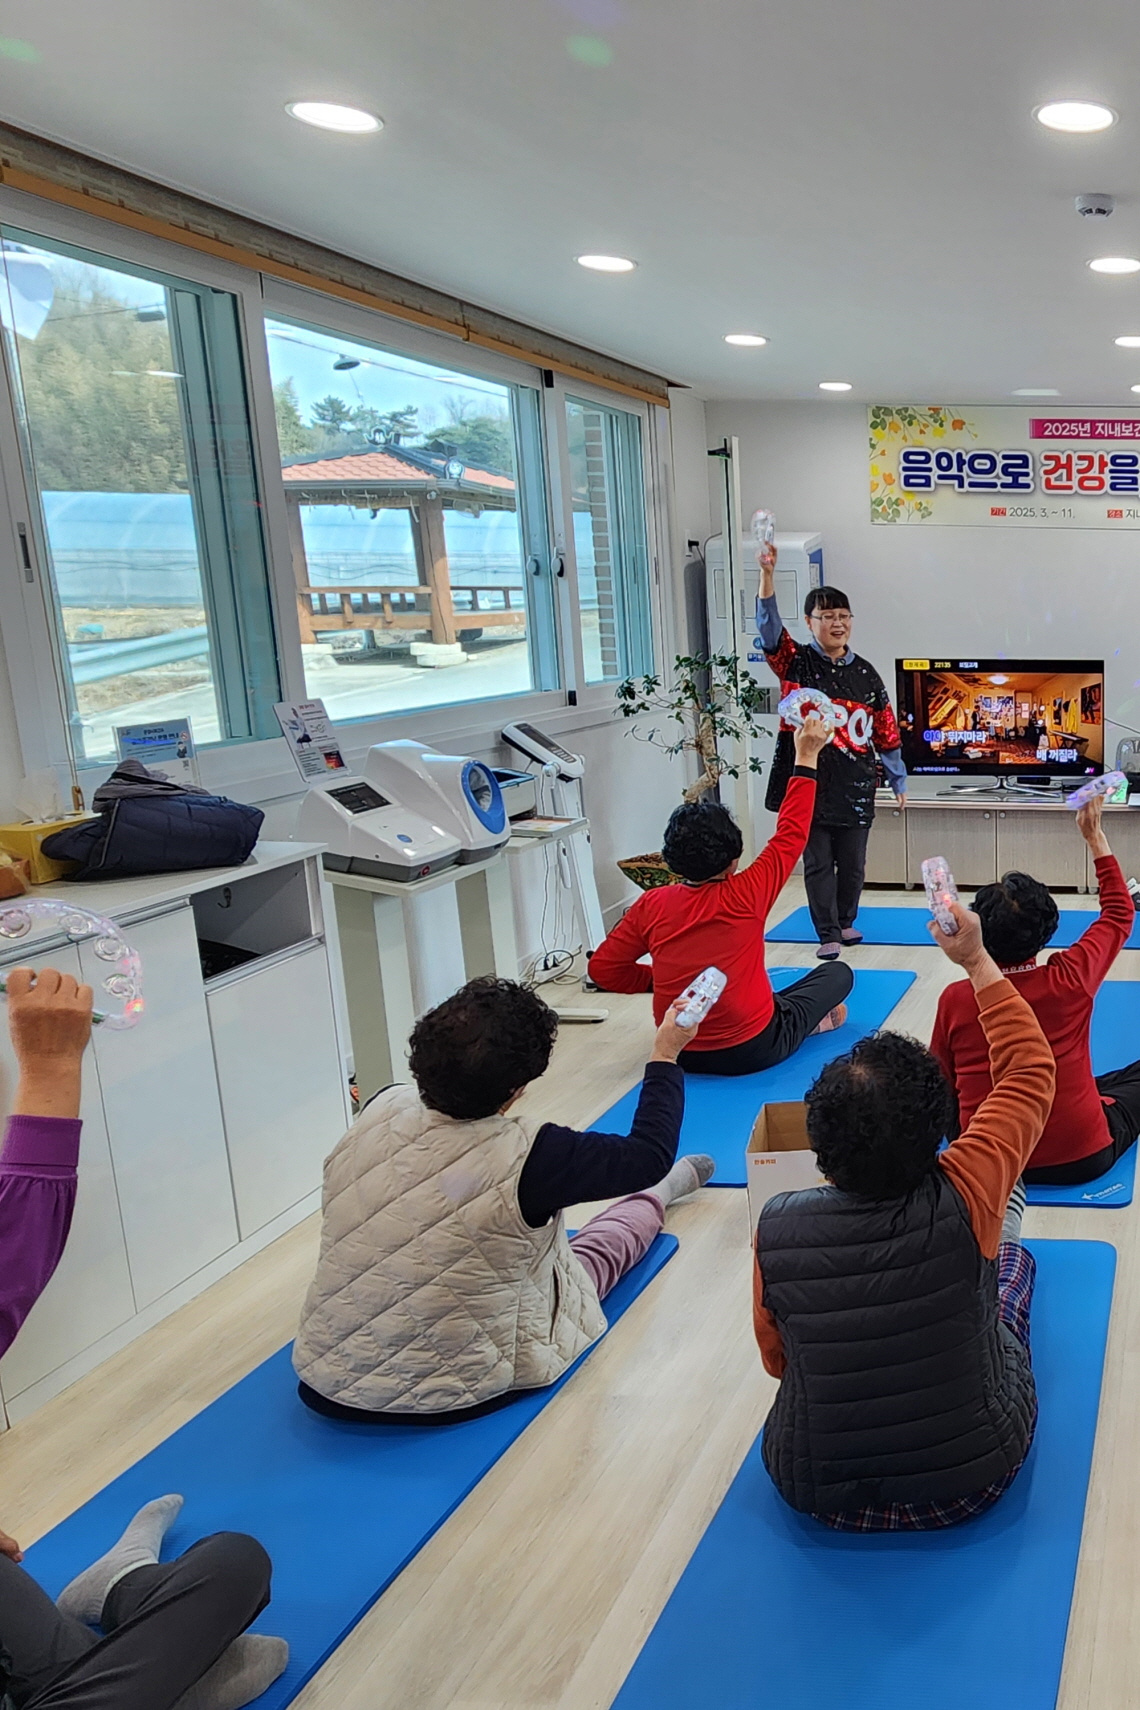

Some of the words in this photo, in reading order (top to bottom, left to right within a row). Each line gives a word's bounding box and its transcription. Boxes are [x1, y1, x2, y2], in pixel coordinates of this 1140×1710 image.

[1043, 422, 1091, 437] 2025년
[900, 448, 1034, 491] 음악으로
[1009, 507, 1037, 518] 2025.
[1041, 508, 1049, 518] 3.
[1062, 508, 1076, 518] 11.
